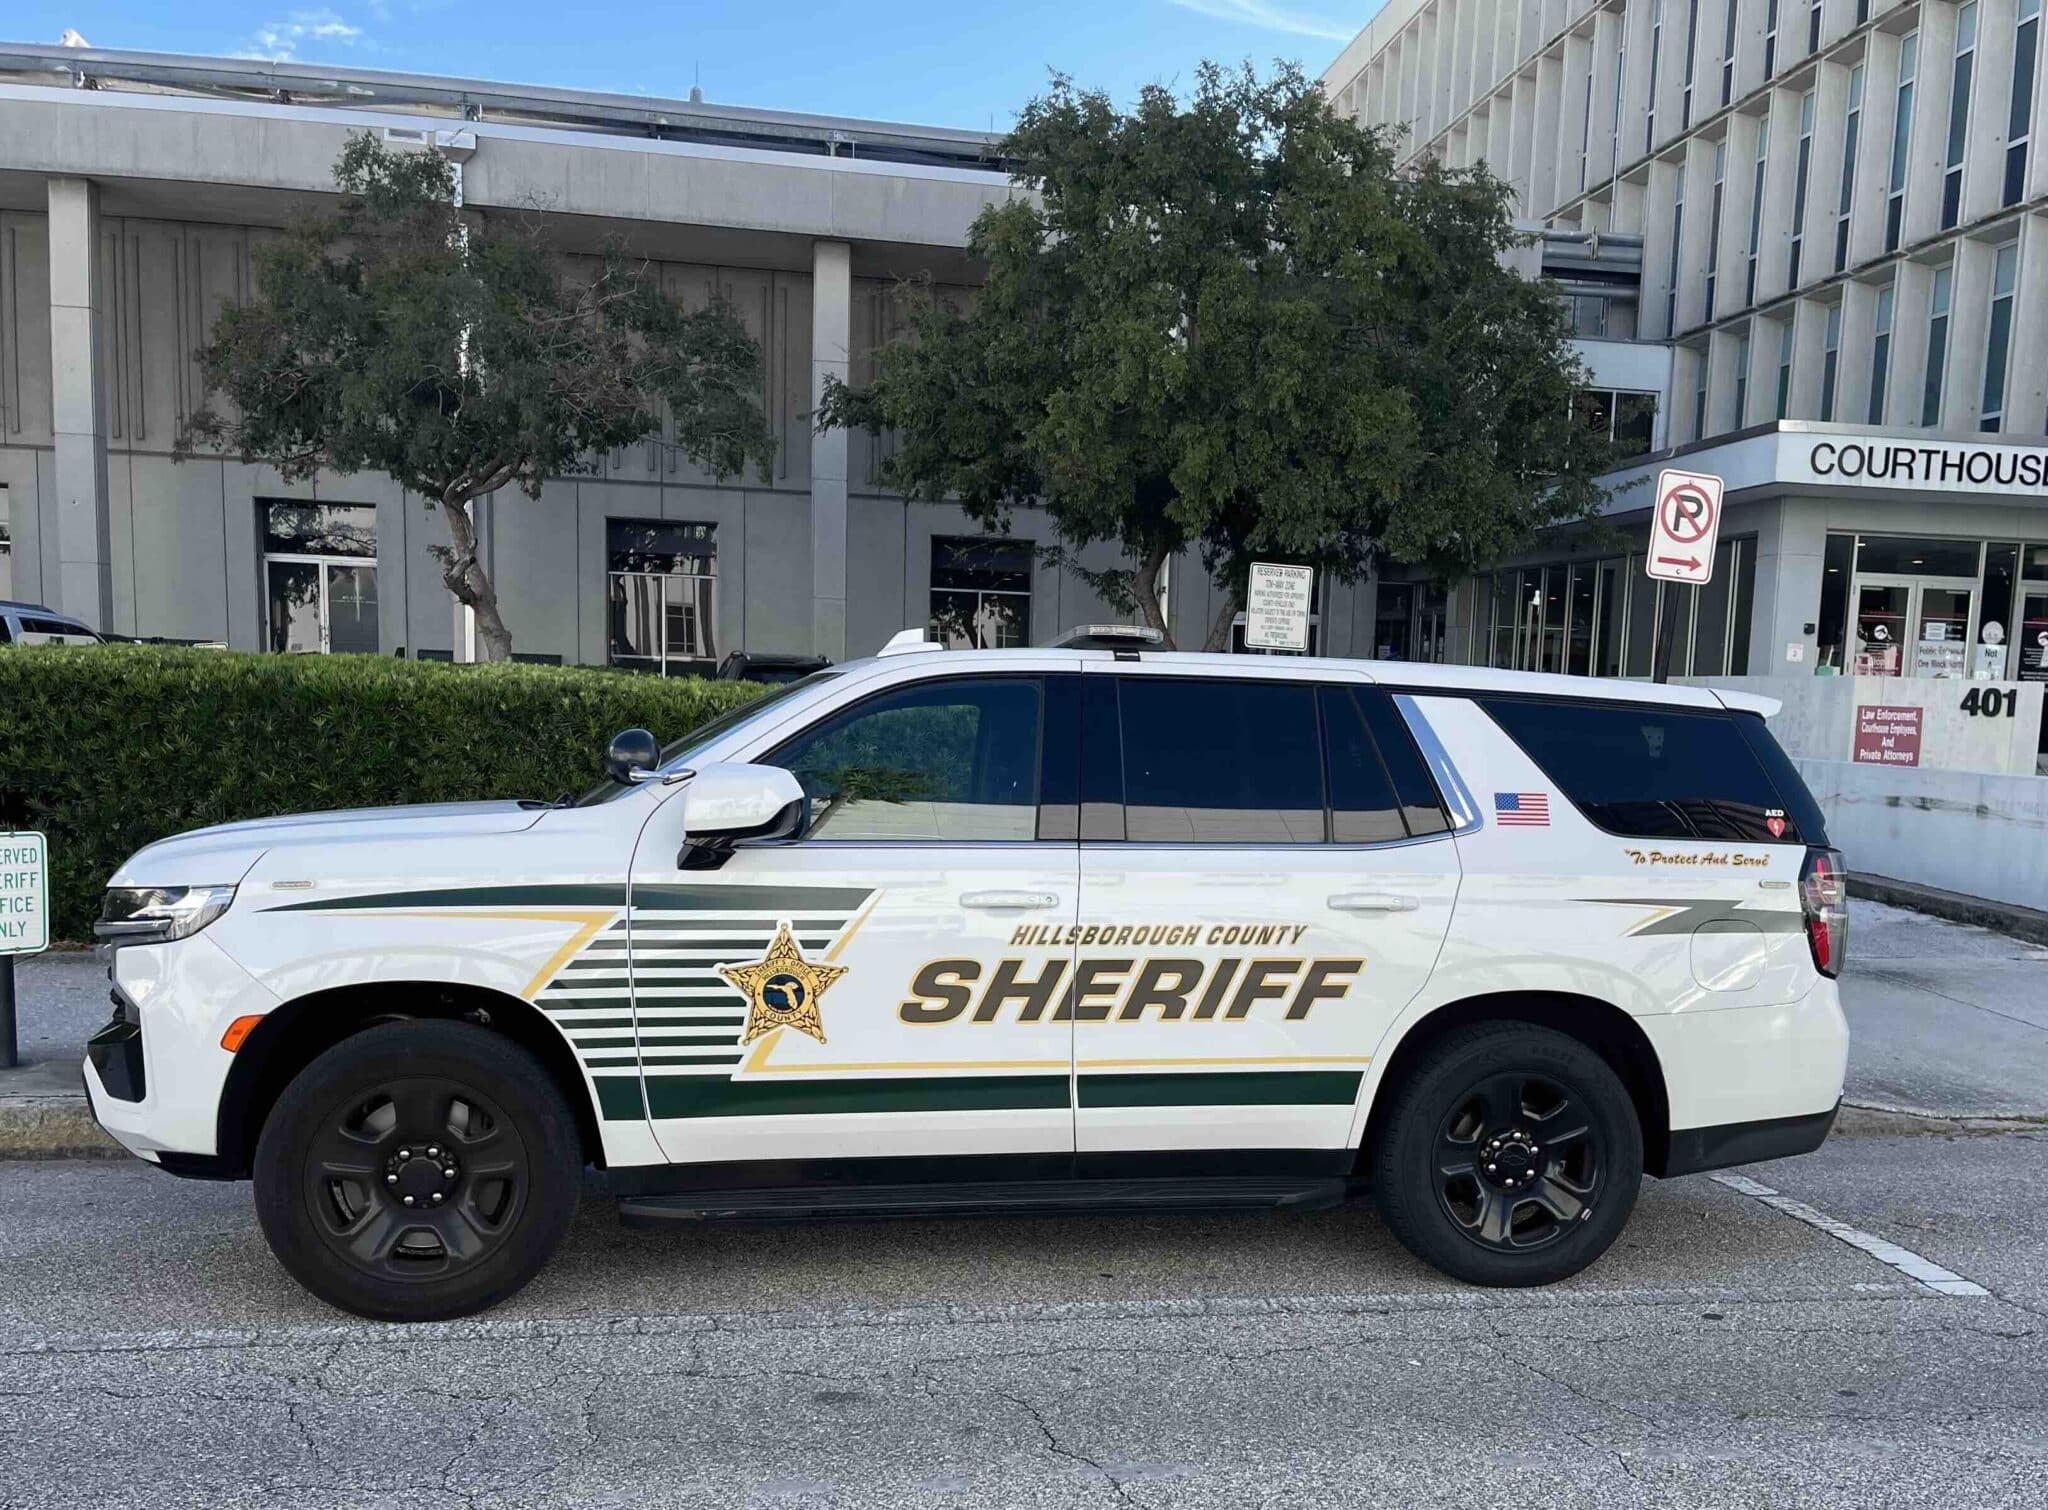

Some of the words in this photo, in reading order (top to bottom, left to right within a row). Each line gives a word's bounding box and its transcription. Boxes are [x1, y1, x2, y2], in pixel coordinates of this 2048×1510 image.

[1960, 688, 2017, 717] 401
[1862, 709, 1875, 720] Law
[1881, 736, 1895, 747] And
[1860, 749, 1881, 760] Private
[1883, 750, 1914, 763] Attorneys
[1649, 852, 1699, 865] Protect
[1700, 852, 1728, 866] And
[1009, 924, 1198, 946] HILLSBOROUGH
[1207, 924, 1310, 946] COUNTY
[790, 960, 812, 976] OFFICE
[897, 957, 1367, 1026] SHERIFF
[764, 1009, 803, 1021] COUNTY
